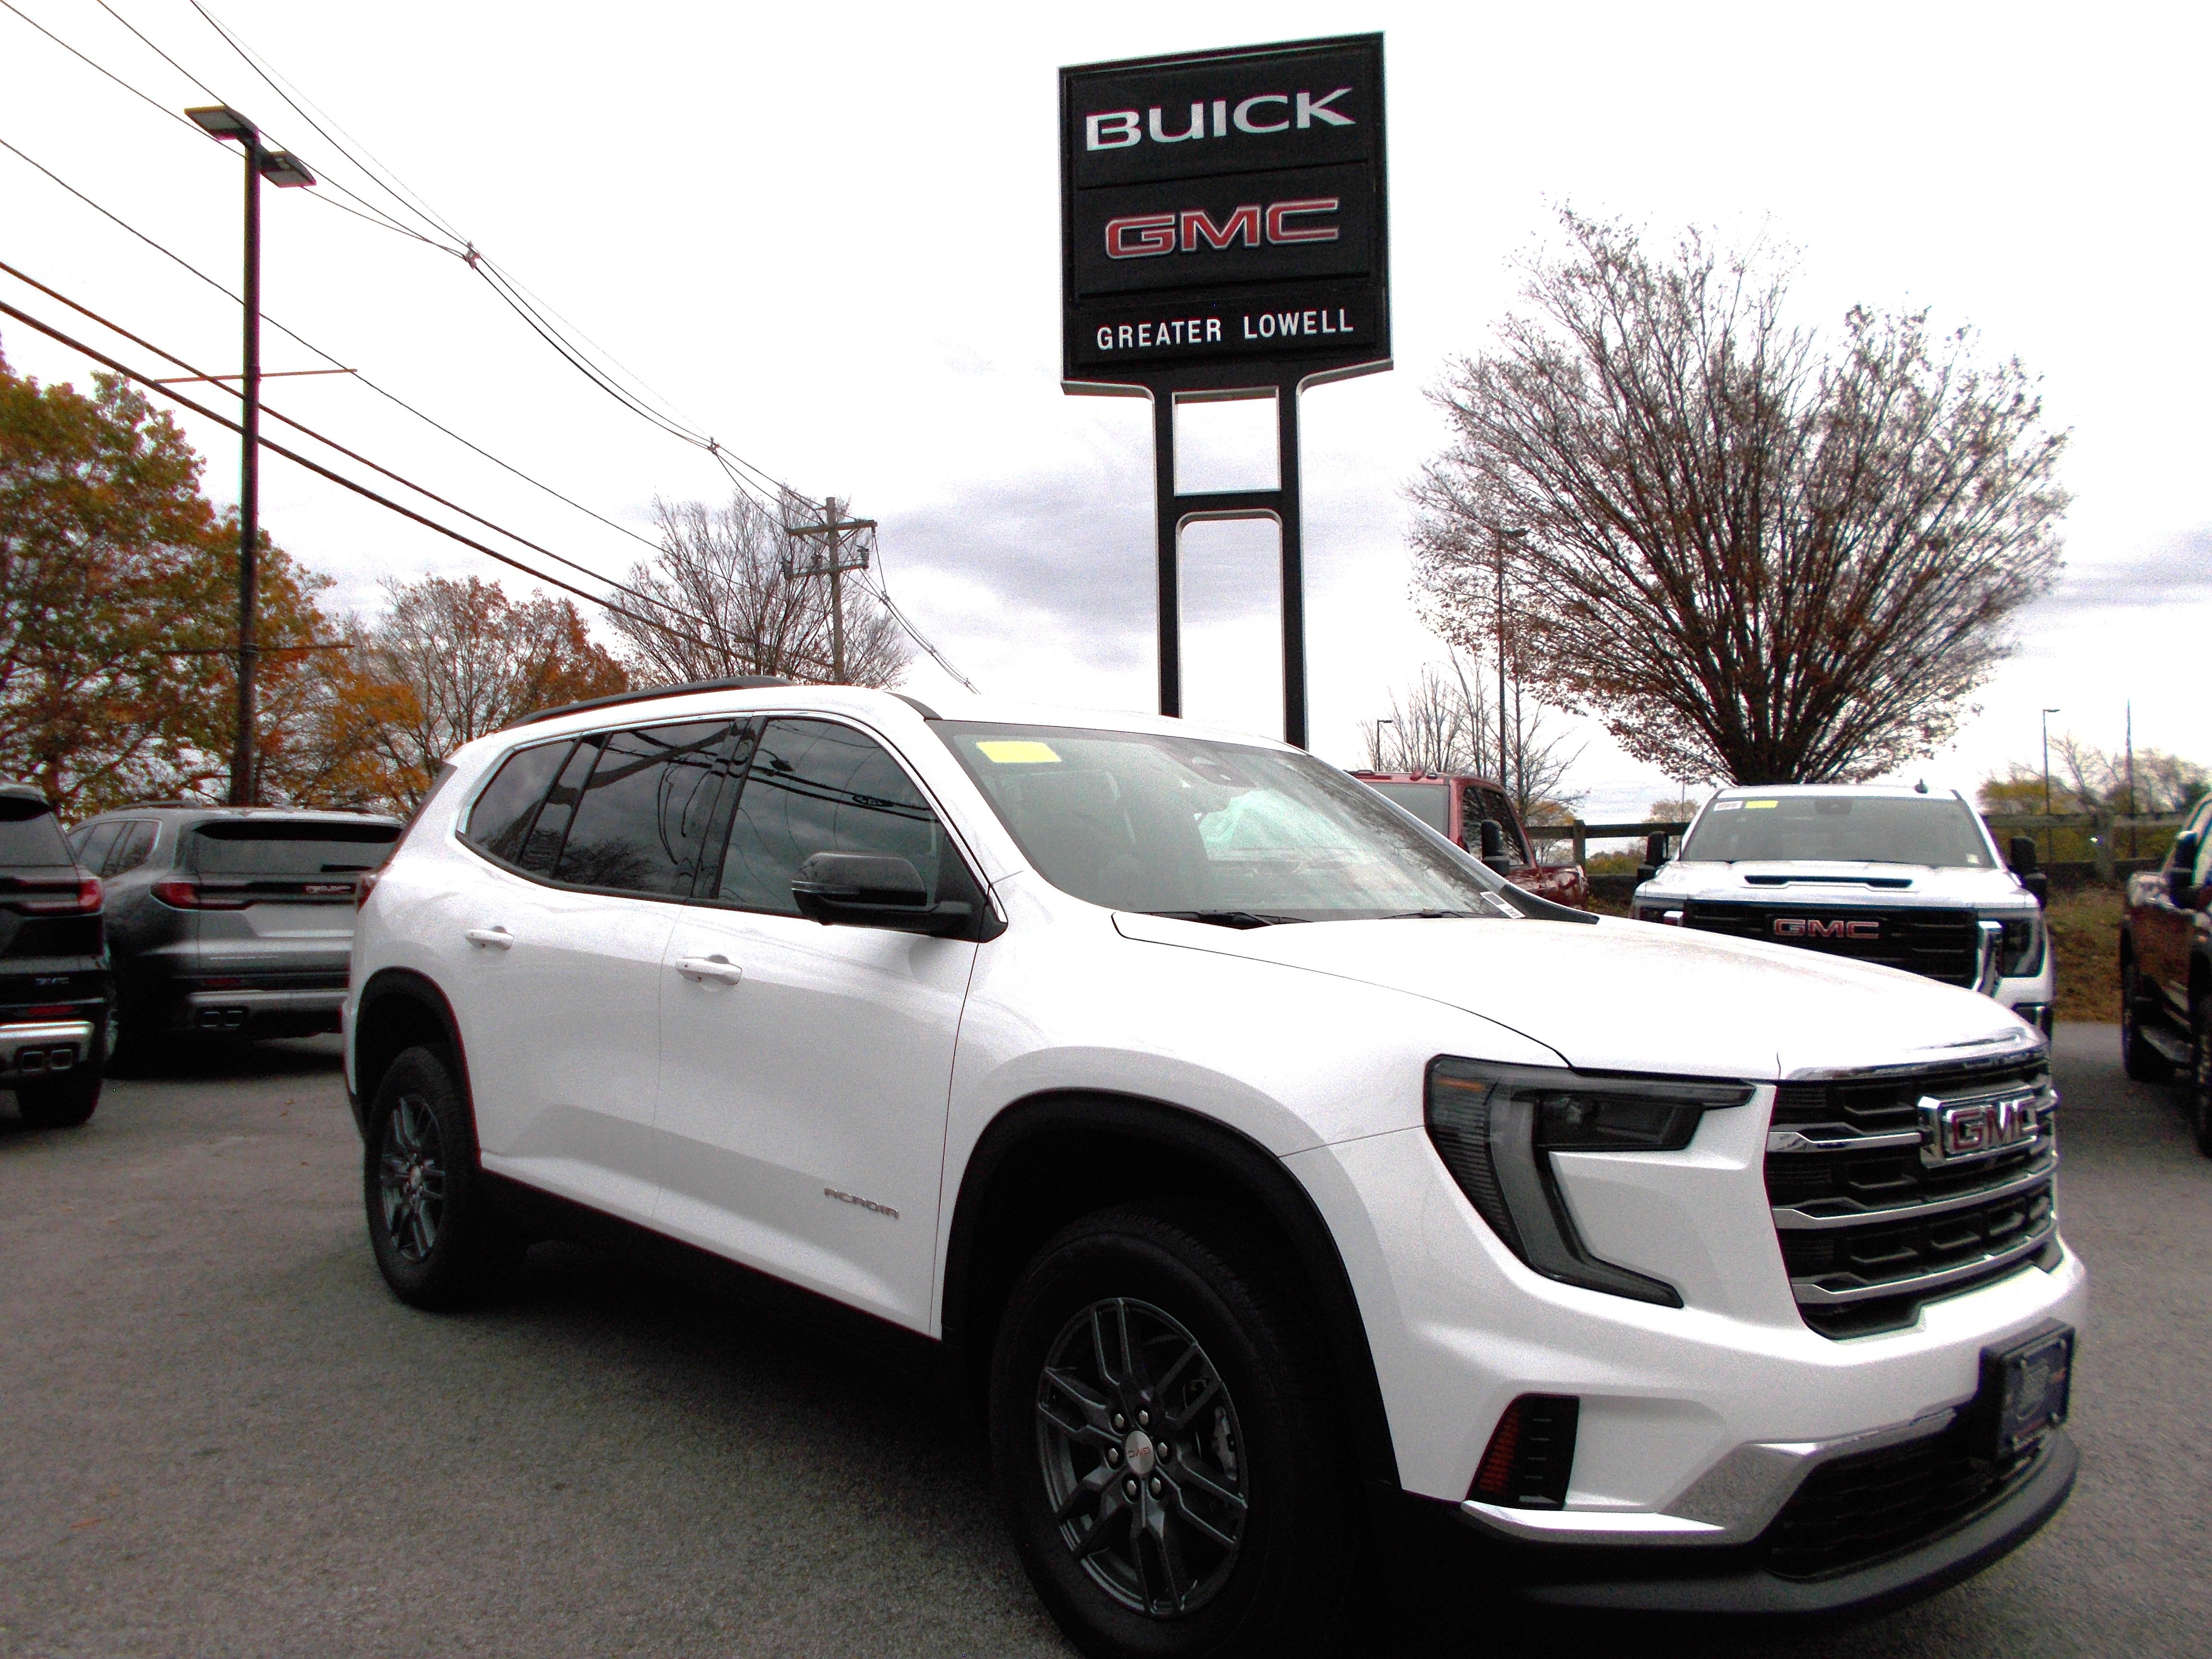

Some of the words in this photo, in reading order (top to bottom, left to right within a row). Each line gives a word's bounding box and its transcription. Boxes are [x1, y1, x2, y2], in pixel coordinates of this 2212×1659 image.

[1085, 87, 1357, 151] BUICK
[1105, 197, 1339, 259] GMC
[1097, 317, 1222, 350] GREATER
[1243, 308, 1354, 339] LOWELL
[1774, 918, 1880, 939] GMC
[1947, 1099, 2039, 1150] GMC
[1128, 1446, 1151, 1458] GMC
